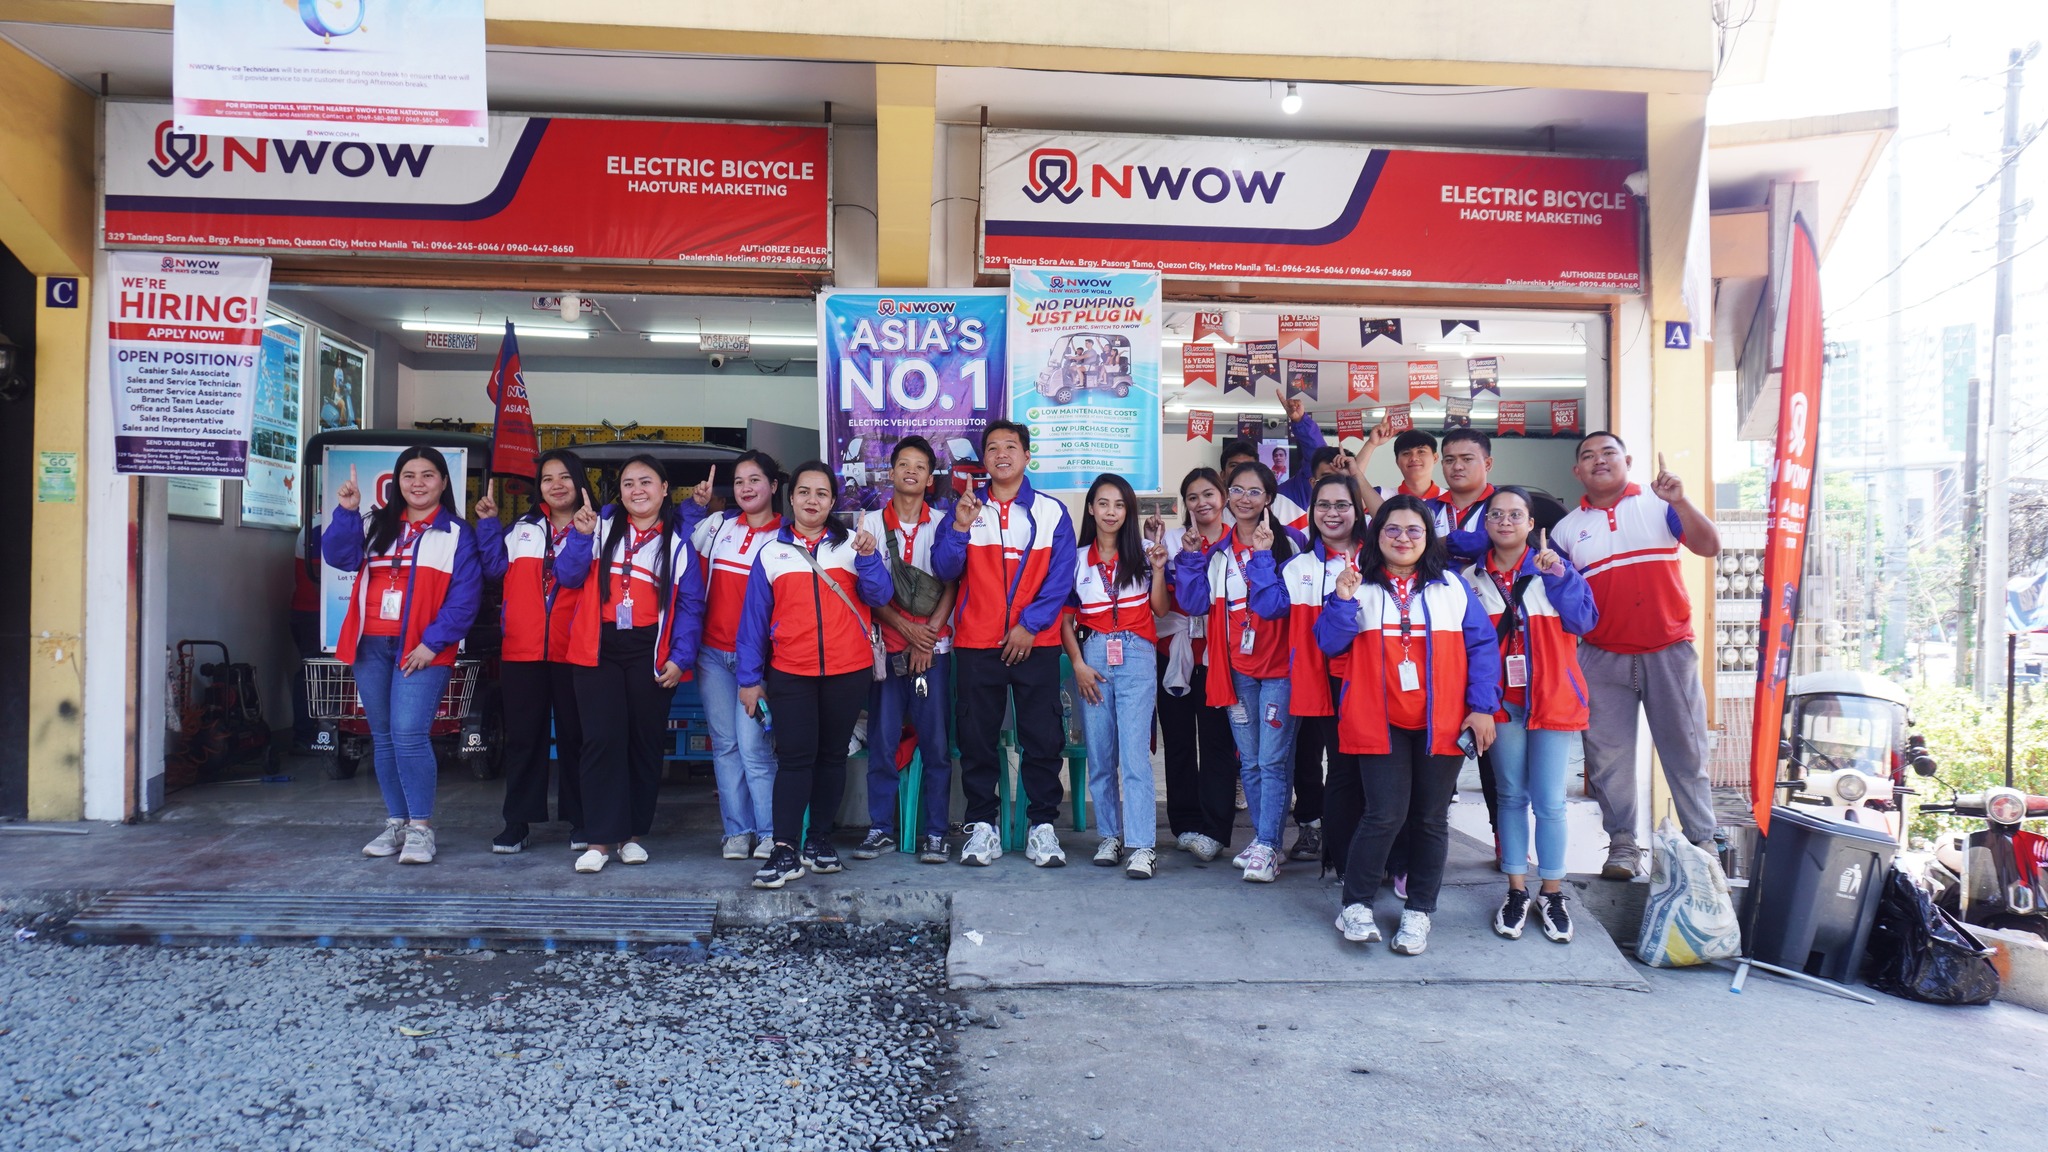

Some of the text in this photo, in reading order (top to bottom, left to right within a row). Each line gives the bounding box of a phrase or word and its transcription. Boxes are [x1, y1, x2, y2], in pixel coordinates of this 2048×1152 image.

[223, 137, 434, 178] NWOW
[606, 156, 814, 180] ELECTRIC BICYCLE
[628, 180, 788, 196] HAOTURE MARKETING
[1092, 164, 1286, 204] NWOW
[1440, 185, 1626, 210] ELECTRIC BICYCLE
[1460, 208, 1602, 225] HAOTURE MARKETING
[108, 232, 574, 253] 329 Tandang Sora Ave. Brgy. Pasong Tamo, Quezon City, Metro Manila Tel.: 0966-245-6046 0960-447-8650
[740, 244, 827, 255] AUTHORIZE DEALER
[176, 259, 220, 269] NWOW
[679, 253, 827, 264] Dealership Hotline: 0929-860-1949
[1003, 256, 1037, 265] Tandang
[1039, 257, 1057, 266] Sora
[1059, 258, 1076, 266] Ave.
[1078, 258, 1099, 268] Brgy.
[1101, 260, 1130, 269] Pasong
[1132, 260, 1155, 269] Tamo,
[1157, 261, 1187, 270] Quezon
[1189, 262, 1207, 271] City,
[1209, 262, 1233, 270] Metro
[1235, 263, 1261, 271] Manila
[1264, 264, 1281, 272] Tel.:
[1282, 264, 1344, 274] 0966-245-6046
[1351, 267, 1412, 277] 0960-447-8650
[1560, 270, 1639, 280] AUTHORIZE DEALER
[122, 277, 166, 289] WE'RE
[1067, 279, 1112, 287] NWOW
[53, 281, 73, 304] C
[120, 291, 258, 324] HIRING!
[898, 302, 957, 313] NWOW
[1035, 297, 1135, 311] NO PUMPING
[1026, 308, 1144, 326] JUST PLUG IN
[1202, 313, 1222, 324] NO.
[147, 328, 224, 341] APPLY NOW!
[448, 334, 476, 342] SERVICE
[849, 316, 984, 352] ASIA'S
[1667, 325, 1688, 345] A
[426, 333, 448, 347] FREE
[448, 340, 476, 349] DELIVERY
[700, 336, 712, 346] NO
[118, 350, 253, 367] OPEN POSITION/S
[138, 366, 229, 377] Cashier Sale Associate
[198, 379, 241, 388] Technician
[840, 357, 988, 412] NO.1
[166, 388, 196, 396] Service
[198, 390, 242, 398] Assistance
[195, 407, 235, 415] Associate
[504, 404, 530, 415] ASIA'S
[162, 416, 224, 424] Representative
[849, 418, 987, 427] ELECTRIC VEHICLE DISTRIBUTOR
[161, 426, 200, 435] Inventory
[202, 427, 241, 436] Associate
[50, 458, 68, 466] GO
